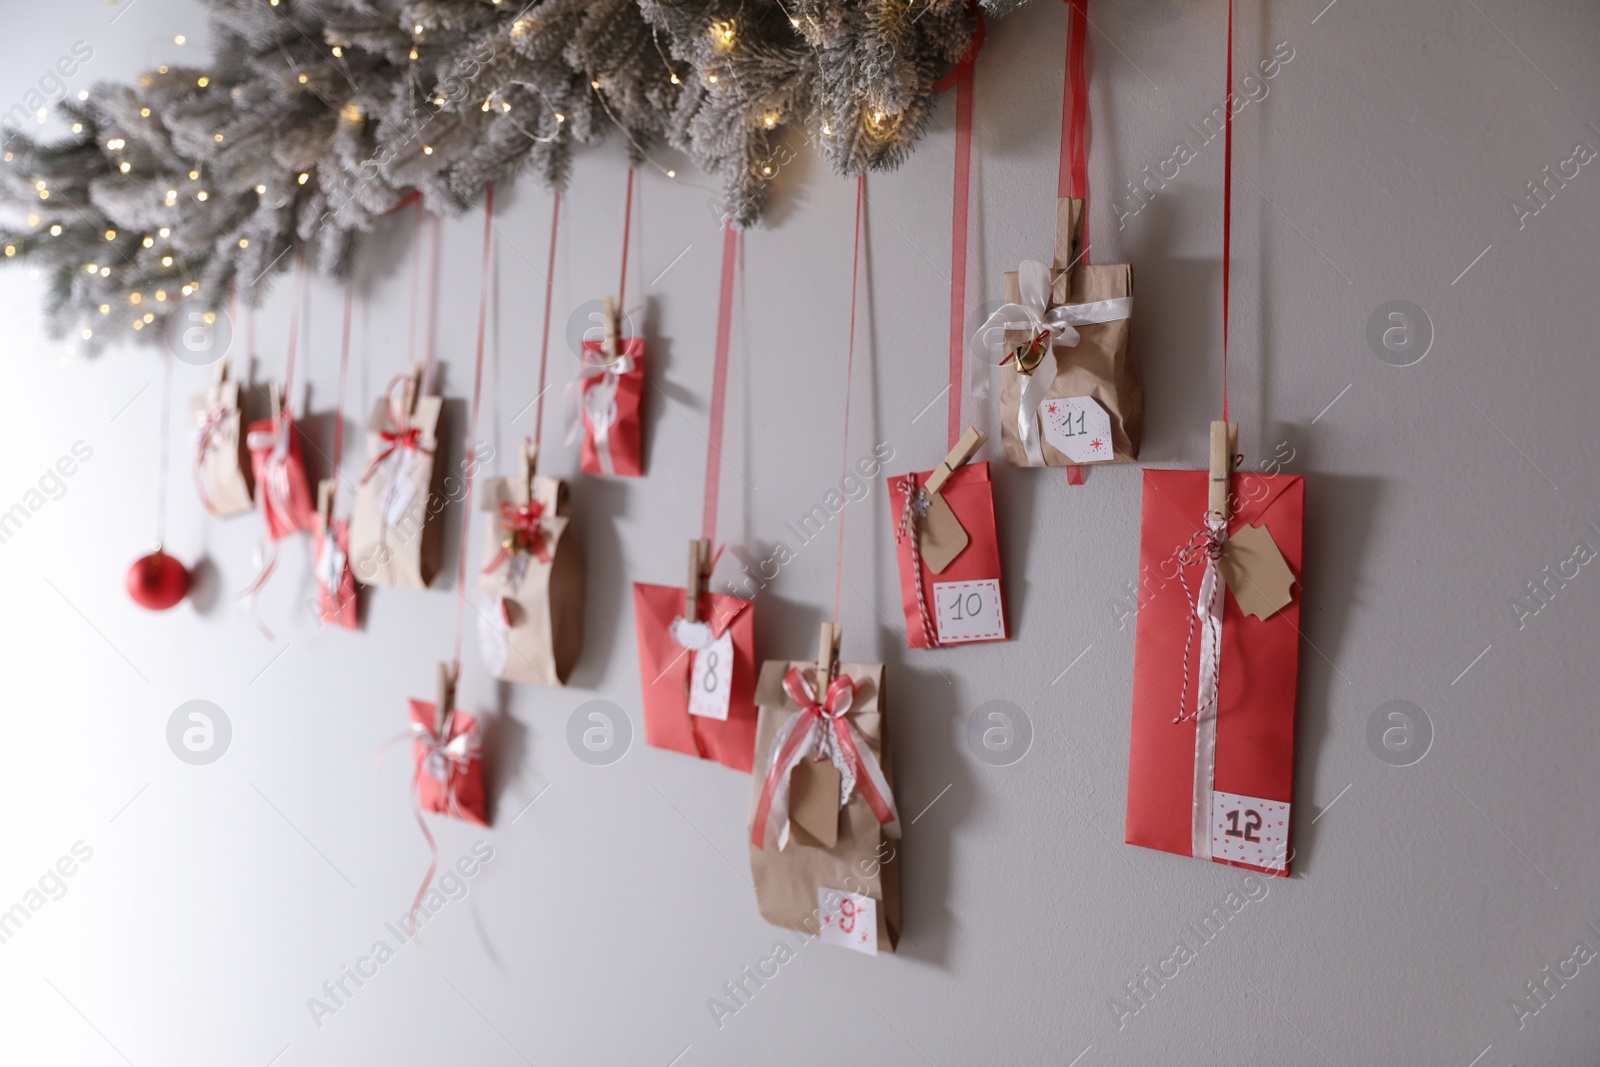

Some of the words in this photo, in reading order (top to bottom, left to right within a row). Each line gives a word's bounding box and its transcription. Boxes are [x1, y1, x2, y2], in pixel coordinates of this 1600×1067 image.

[1062, 410, 1087, 437] 11
[949, 593, 982, 620] 10
[703, 651, 718, 693] 8
[1225, 809, 1262, 843] 12
[839, 898, 855, 934] 9
